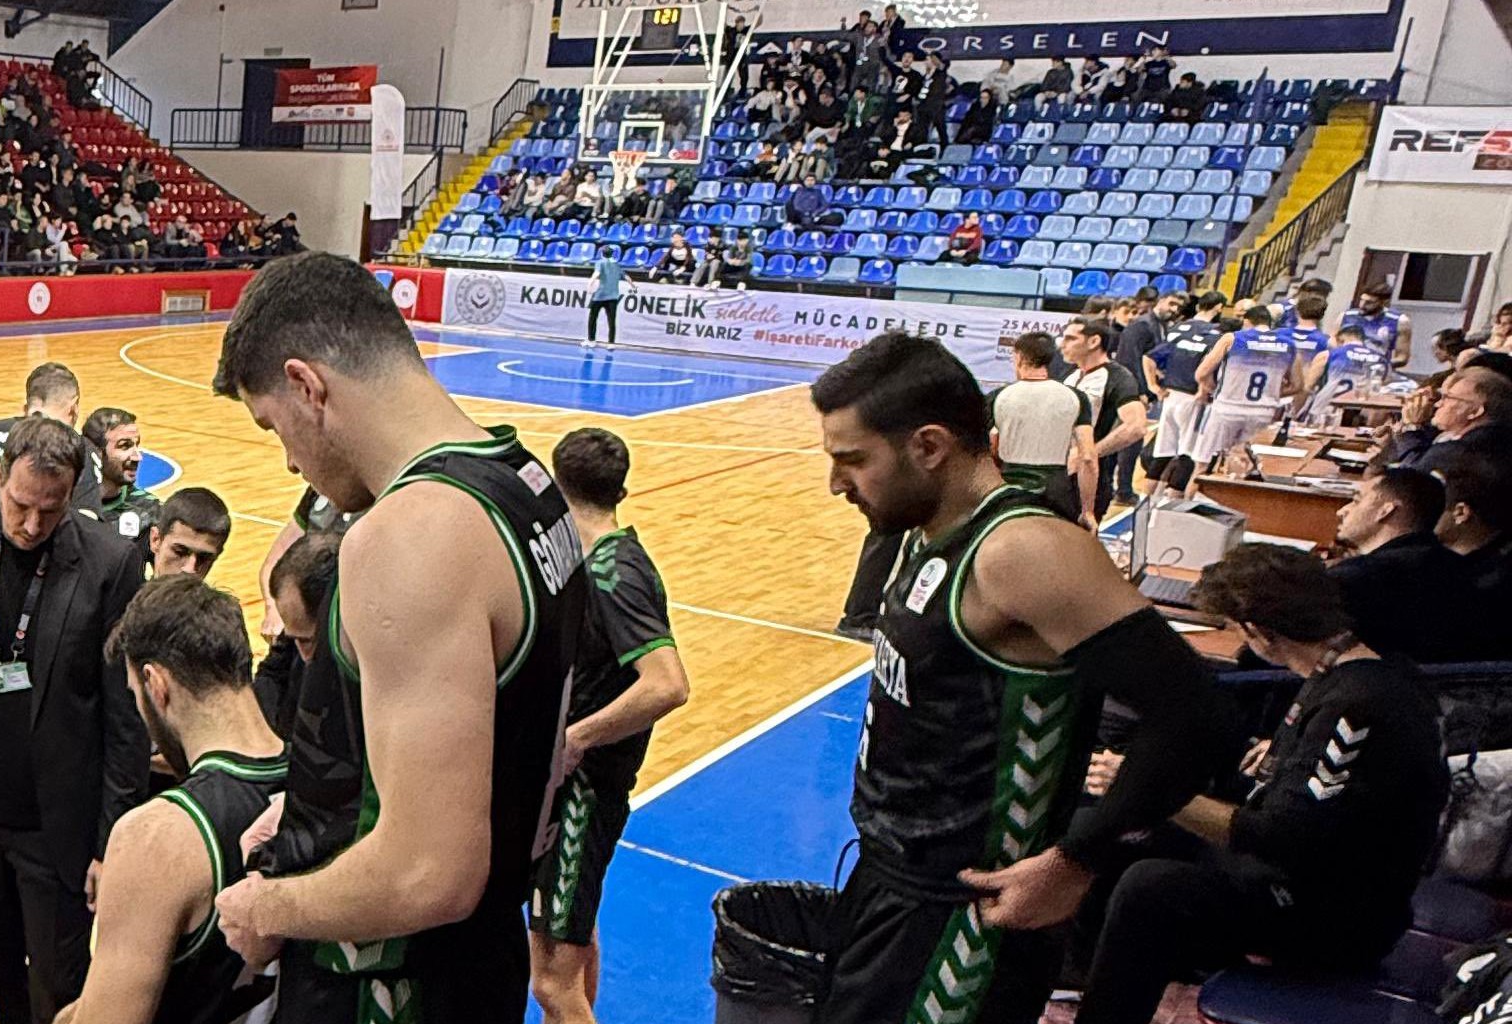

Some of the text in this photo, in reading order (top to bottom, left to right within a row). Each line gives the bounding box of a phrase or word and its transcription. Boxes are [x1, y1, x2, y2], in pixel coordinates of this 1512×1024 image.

[520, 285, 591, 309] KADIN
[665, 319, 692, 336] BİZ
[695, 323, 743, 341] VARIZ
[1002, 319, 1019, 330] 25
[1245, 371, 1268, 401] 8
